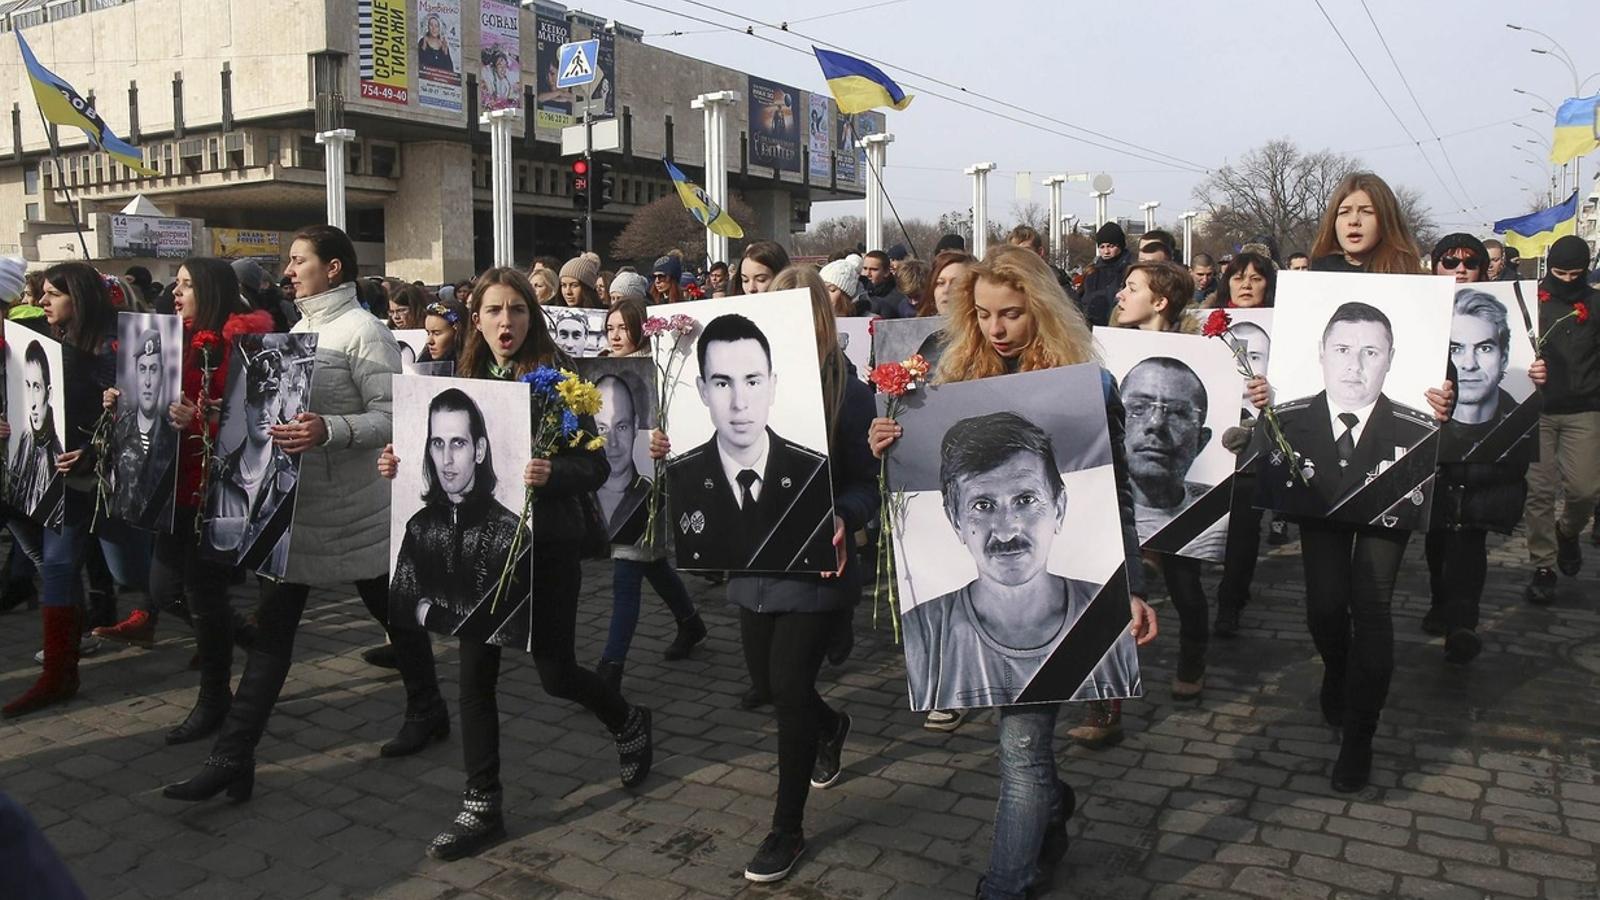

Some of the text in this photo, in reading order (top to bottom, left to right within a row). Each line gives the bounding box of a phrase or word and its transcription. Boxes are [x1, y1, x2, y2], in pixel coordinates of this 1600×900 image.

[481, 13, 518, 30] GORAN
[540, 22, 568, 37] KEIKO
[374, 0, 390, 79] СРОЧНЫЕ
[390, 8, 406, 76] ТИРАЖИ
[362, 84, 407, 102] 754-49-40
[575, 178, 586, 189] 34
[113, 217, 127, 226] 14
